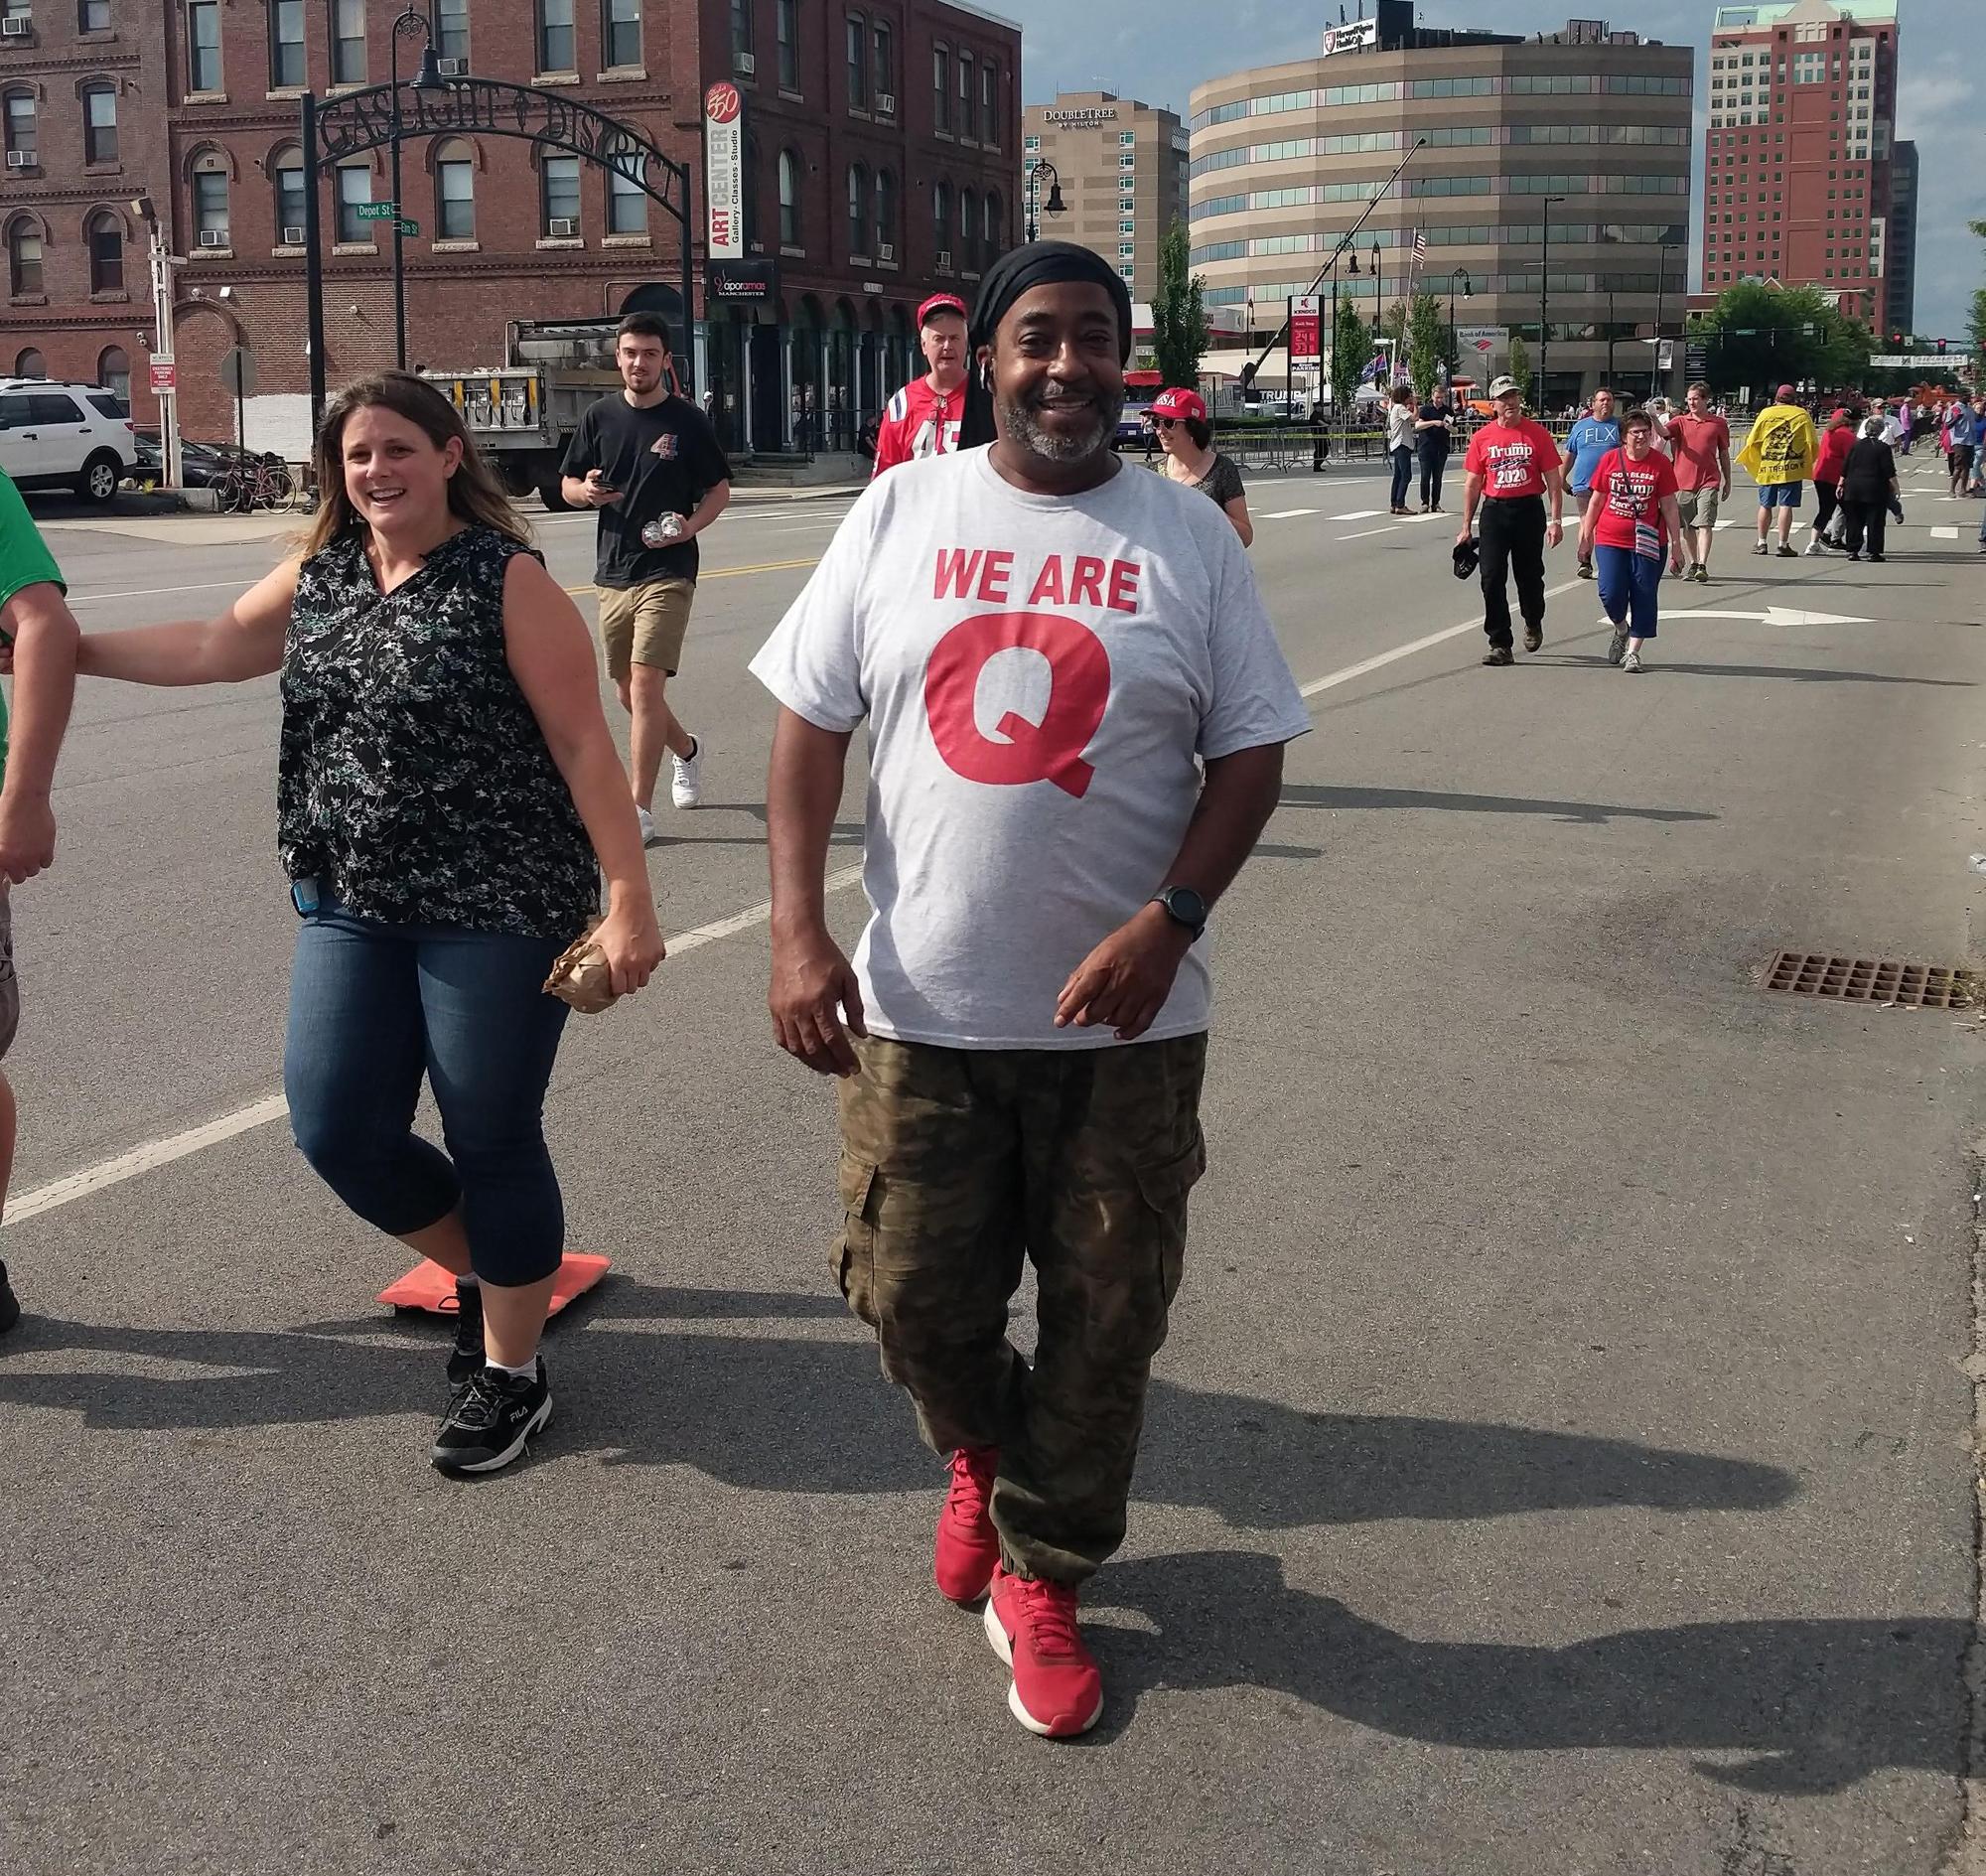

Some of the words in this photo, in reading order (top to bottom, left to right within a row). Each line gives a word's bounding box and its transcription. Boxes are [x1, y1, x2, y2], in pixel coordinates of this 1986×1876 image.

[706, 89, 739, 119] 550
[730, 129, 739, 161] Studio
[710, 128, 729, 207] CENTER
[358, 205, 379, 218] Depot
[381, 205, 391, 216] St
[712, 208, 730, 247] ART
[732, 211, 741, 243] Gallery
[1584, 426, 1617, 444] FLX
[1488, 445, 1533, 460] Trump
[1496, 467, 1527, 485] 2020
[1609, 477, 1655, 497] Trump
[933, 547, 1015, 604] WE
[1027, 553, 1141, 614] ARE
[923, 611, 1111, 799] Q
[509, 1405, 529, 1423] FILA
